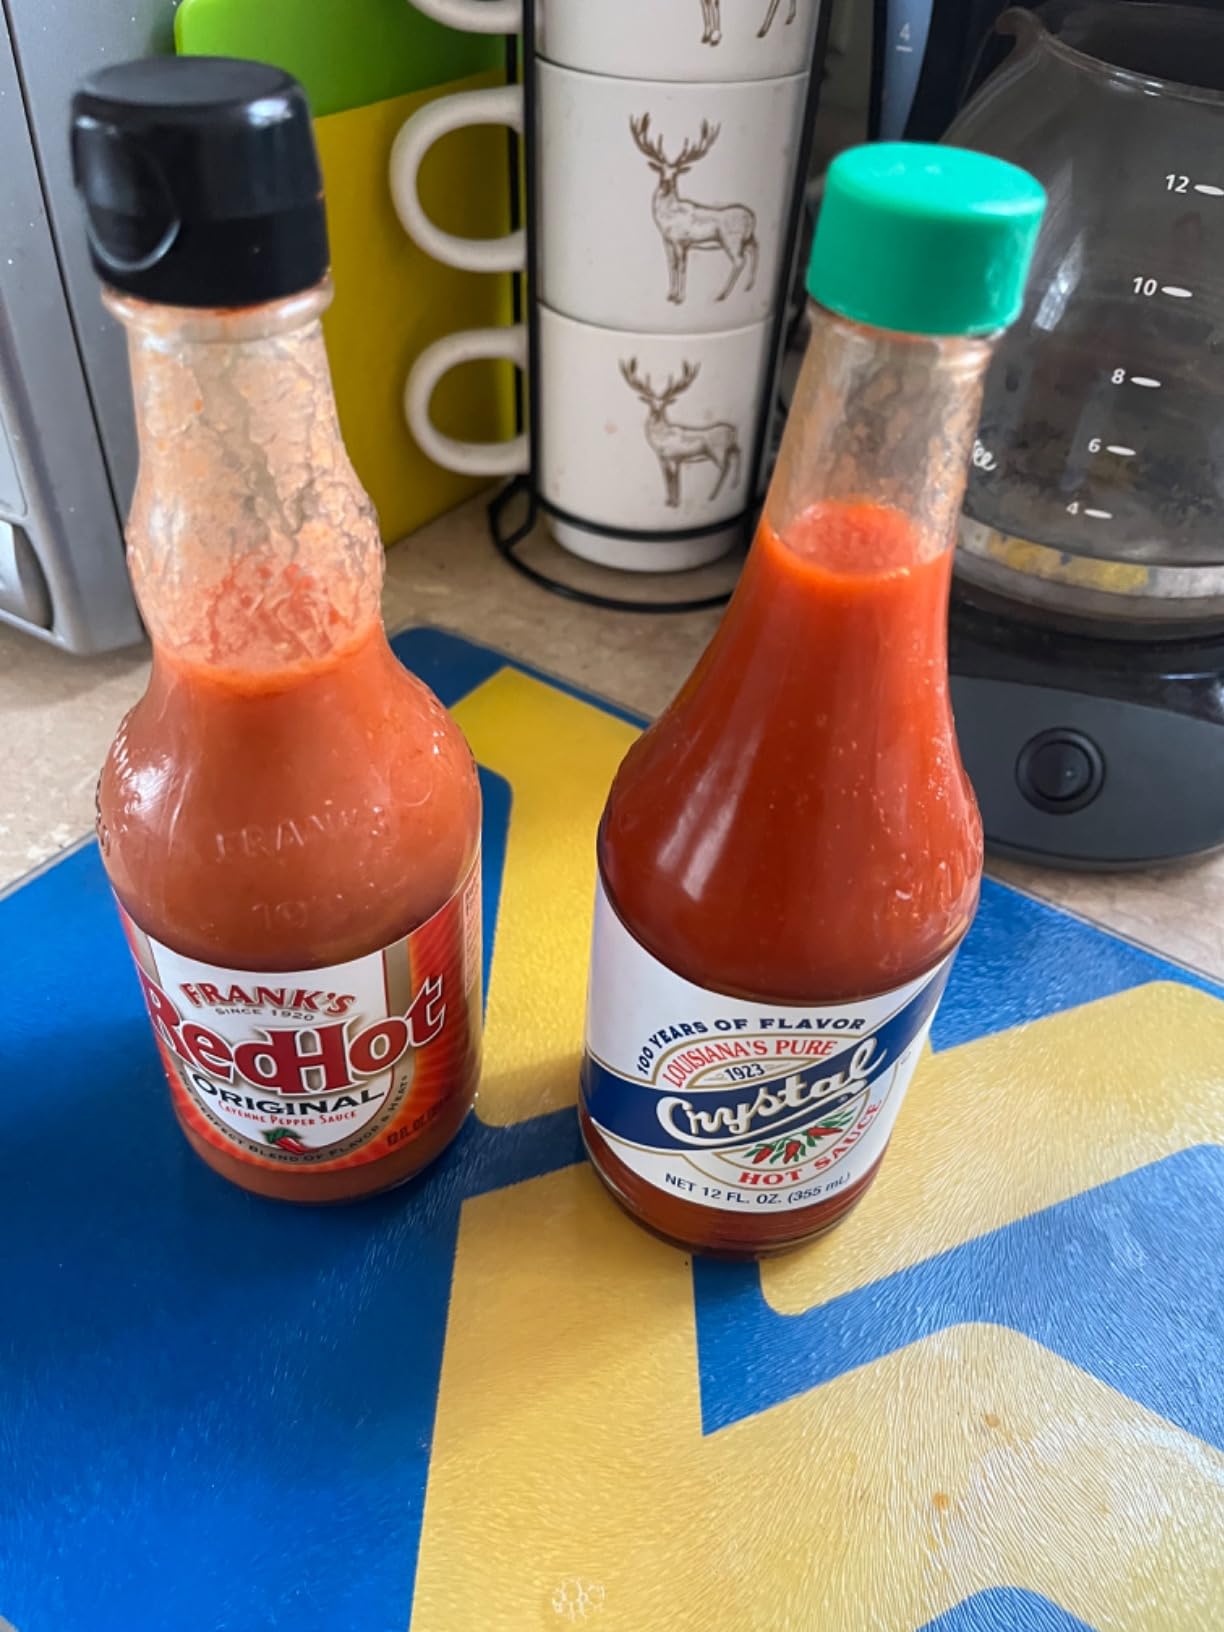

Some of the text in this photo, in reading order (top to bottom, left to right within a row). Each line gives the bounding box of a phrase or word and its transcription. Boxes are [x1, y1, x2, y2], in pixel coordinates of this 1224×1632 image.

[899, 22, 911, 41] 4
[1165, 173, 1190, 194] 12
[1133, 276, 1158, 297] 10
[1111, 367, 1126, 385] 8
[1088, 438, 1102, 453] 6
[1066, 501, 1080, 516] 4
[179, 982, 357, 1017] FRANK'S
[215, 1006, 315, 1022] SINCE 1920
[138, 972, 447, 1096] RedHot
[636, 1017, 867, 1076] 100 YEARS OF FLAVOR
[662, 1038, 839, 1089] LOUISIANA'S PURE
[723, 1062, 766, 1083] 1923
[192, 1072, 385, 1117] ORIGINAL
[656, 1036, 888, 1146] Crystal
[737, 1103, 880, 1186] HOT SAUCE
[664, 1172, 697, 1193] NET
[702, 1186, 722, 1200] 12
[725, 1191, 750, 1204] FL.
[756, 1193, 782, 1205] OZ.
[788, 1184, 823, 1205] (355
